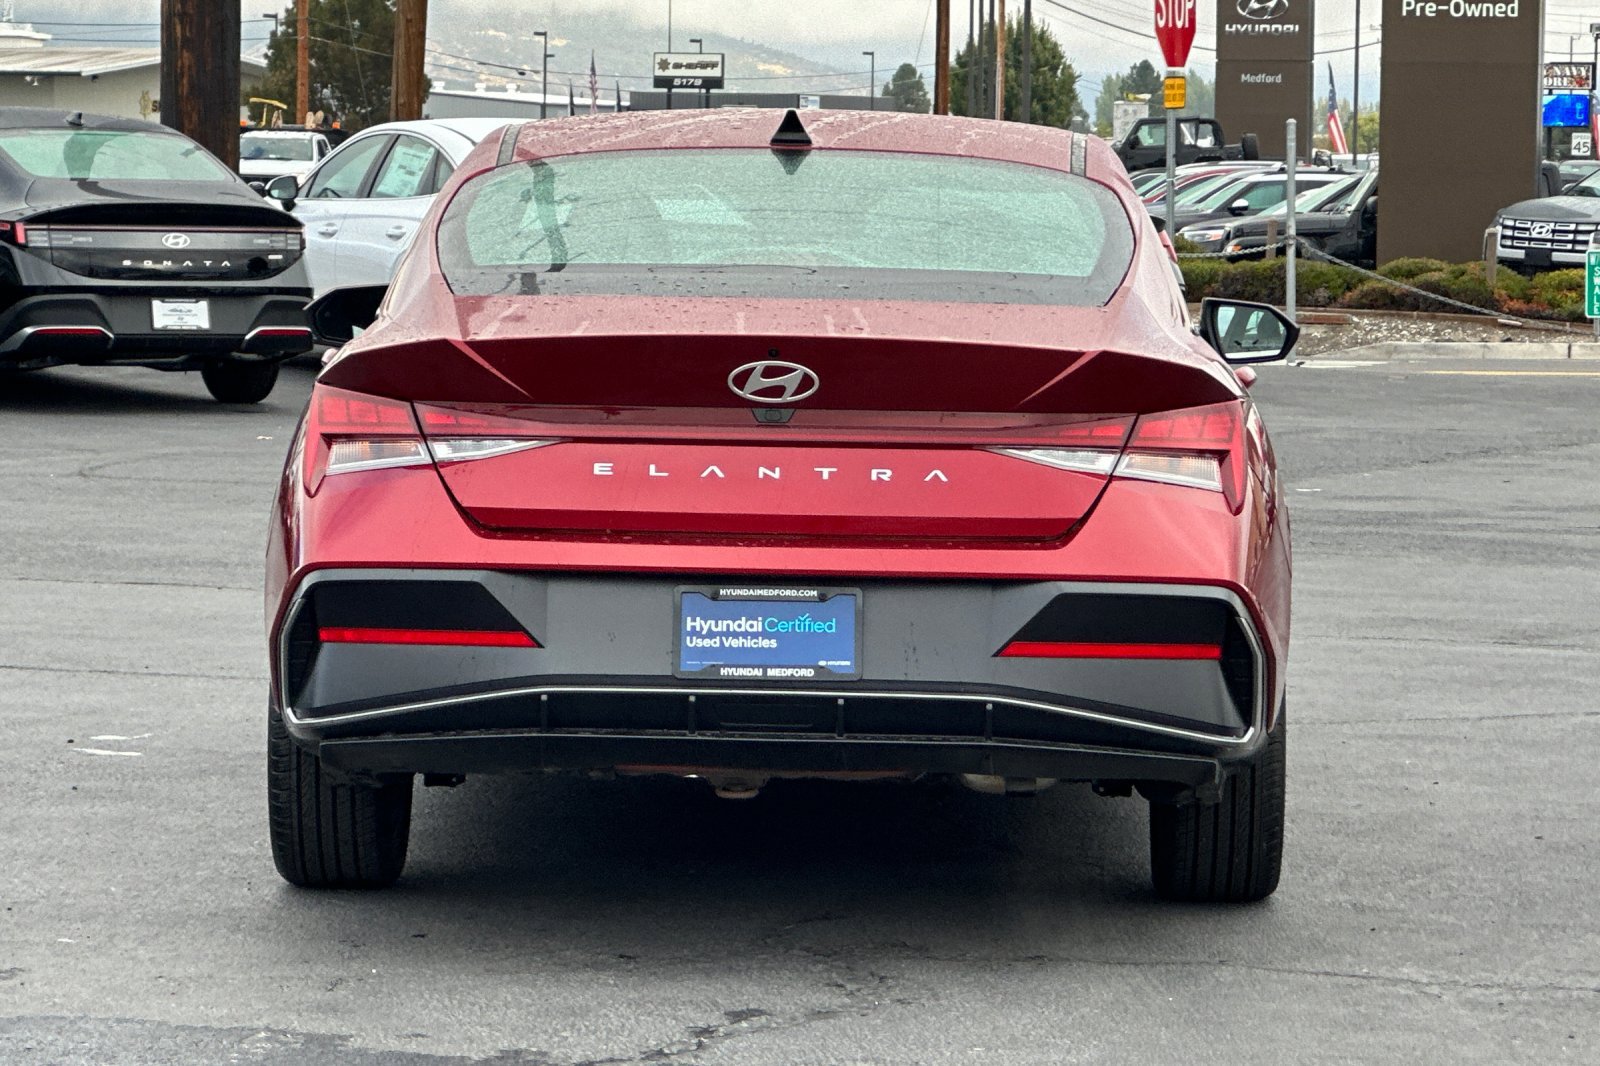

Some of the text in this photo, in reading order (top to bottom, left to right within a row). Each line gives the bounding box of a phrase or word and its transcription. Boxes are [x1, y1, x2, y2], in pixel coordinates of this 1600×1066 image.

[1157, 0, 1194, 28] STOP
[1401, 0, 1519, 17] Pre-Owned
[1225, 24, 1299, 35] HYUNDAI
[1553, 65, 1588, 77] NAVY
[673, 78, 703, 86] 5179
[1241, 73, 1282, 83] Medford
[1543, 77, 1568, 87] ORE
[1573, 141, 1590, 154] 45
[122, 259, 231, 267] SONATA
[593, 463, 949, 482] ELANTRA
[719, 589, 818, 597] HYUNDAIMEDFORD.COM
[686, 614, 836, 635] Hyundai Certified
[686, 636, 777, 648] Used Vehicles
[720, 667, 815, 677] HYUNDAI MEDFORD
